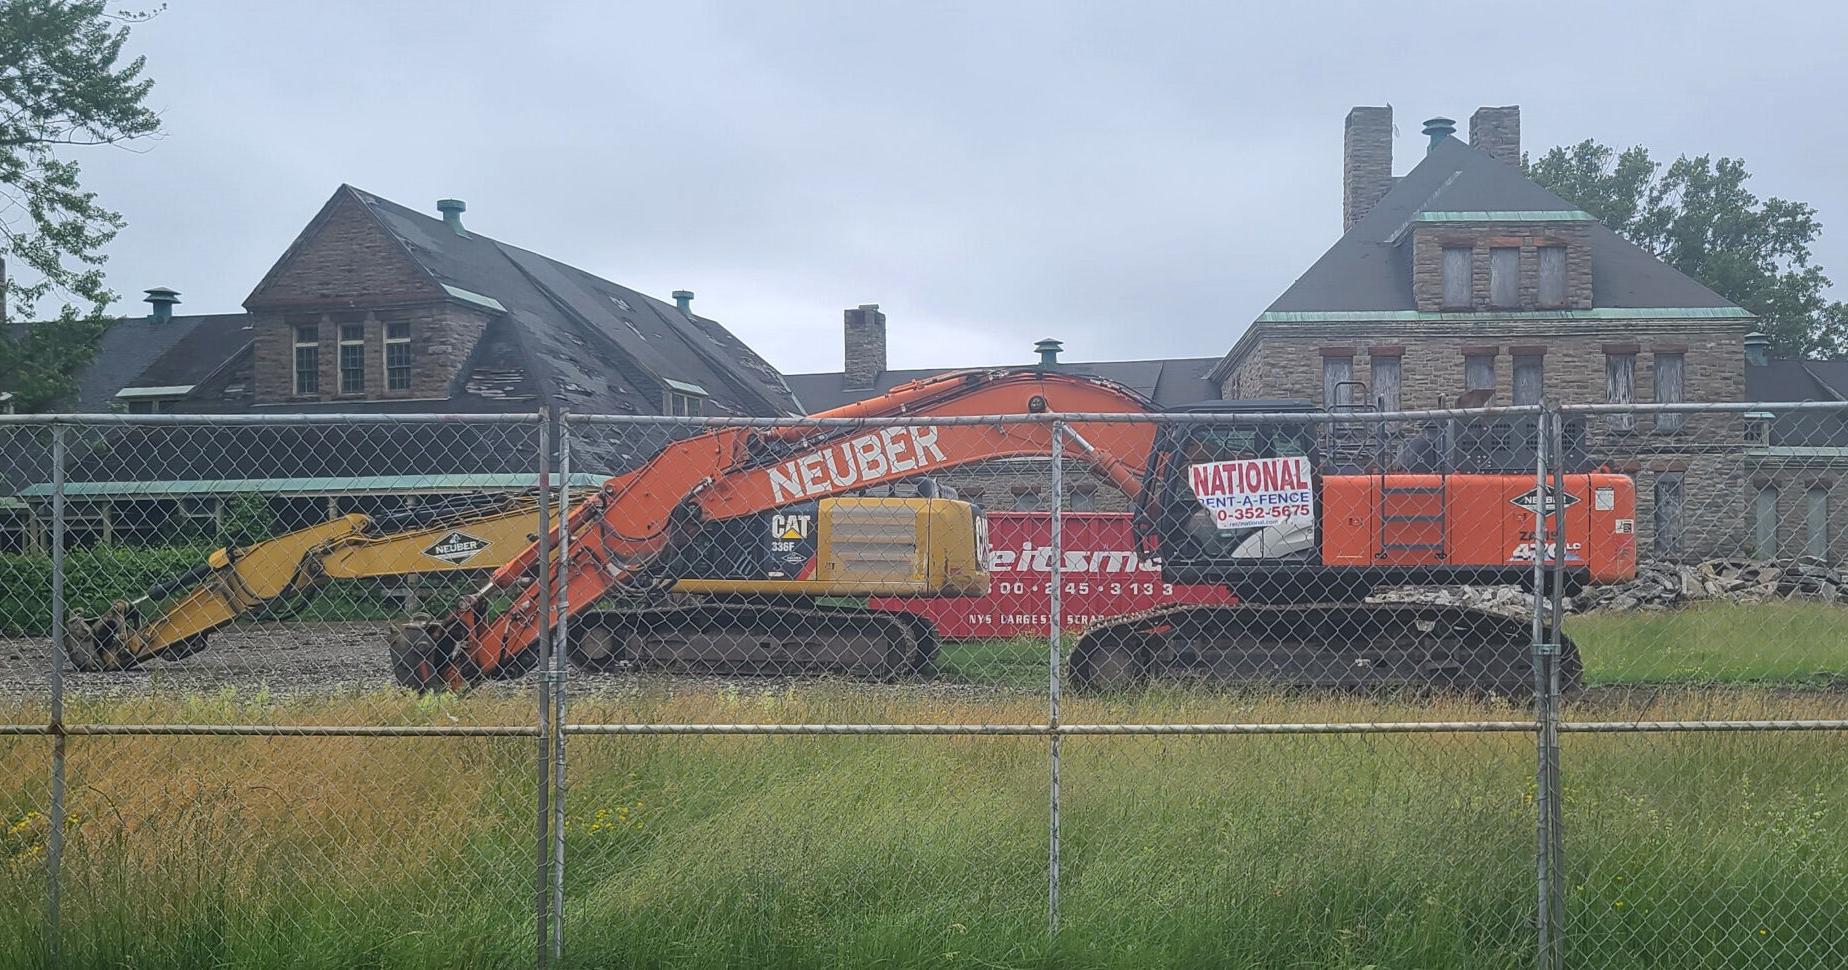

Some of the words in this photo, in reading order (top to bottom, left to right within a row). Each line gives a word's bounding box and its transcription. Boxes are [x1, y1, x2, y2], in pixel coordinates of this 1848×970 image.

[767, 425, 947, 503] NEUBER
[1193, 459, 1308, 496] NATIONAL
[771, 514, 811, 539] CAT
[435, 541, 478, 554] NEUBER
[771, 541, 796, 552] 336F
[969, 614, 992, 624] NYS
